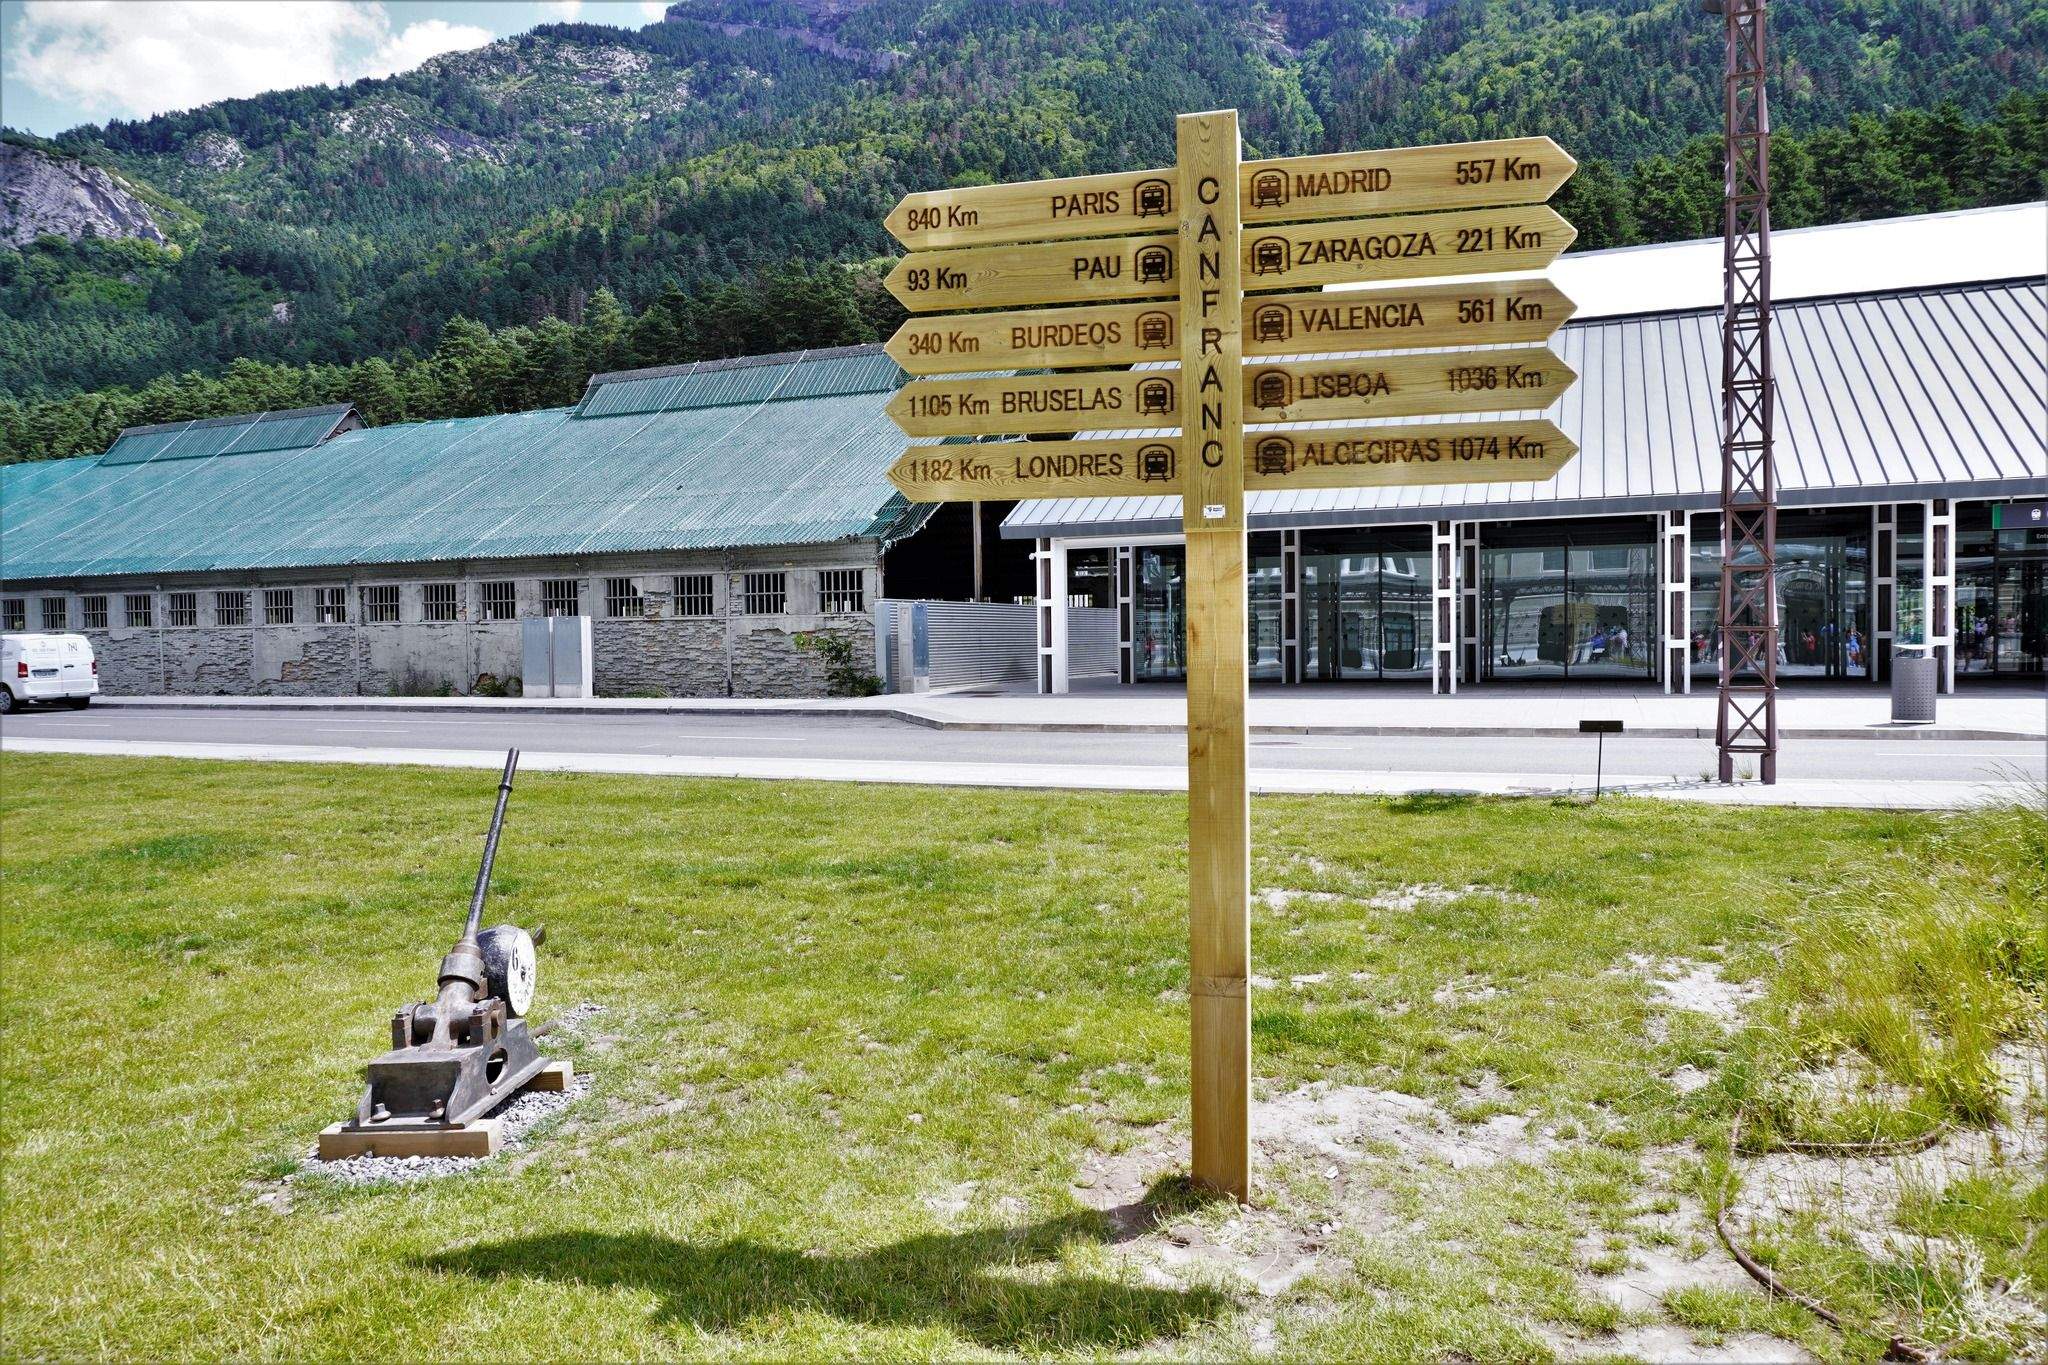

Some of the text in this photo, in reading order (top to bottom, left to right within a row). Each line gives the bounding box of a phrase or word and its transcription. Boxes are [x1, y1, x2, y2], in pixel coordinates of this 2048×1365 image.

[1296, 157, 1541, 197] MADRID 557 Km
[907, 191, 1120, 231] 840 Km PARIS
[1297, 226, 1542, 266] ZARAGOZA 221 Km
[908, 256, 1122, 291] 93 Km PAU
[1198, 177, 1223, 468] CANFRANC
[1300, 297, 1543, 332] VALENCIA 561 Km
[908, 322, 1122, 355] 340 Km BURDEOS
[1300, 365, 1542, 399] LISBOA 1036 Km
[909, 387, 1122, 417] 1105 Km BRUSELAS
[909, 453, 1123, 481] 1182 Km LONDRES
[1302, 435, 1544, 466] ALGECIRAS 1074 Km
[512, 947, 518, 971] 6
